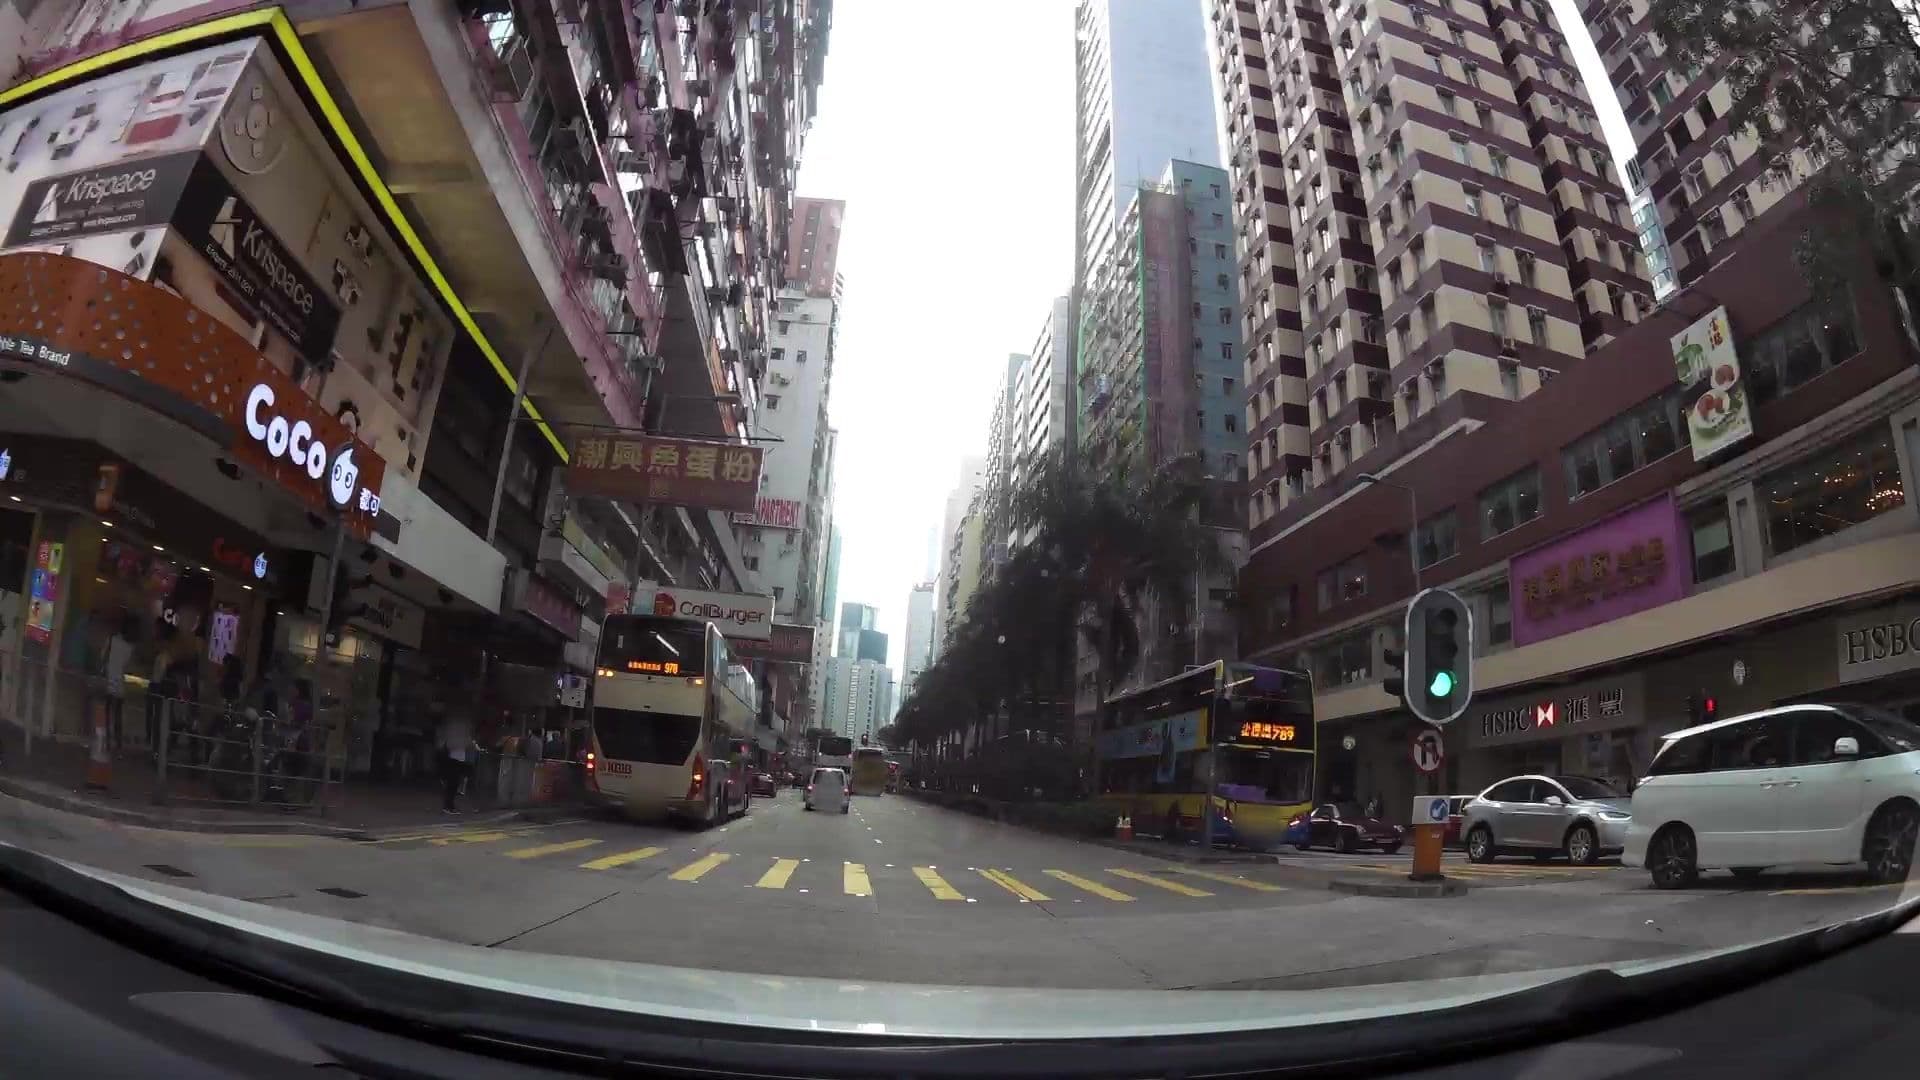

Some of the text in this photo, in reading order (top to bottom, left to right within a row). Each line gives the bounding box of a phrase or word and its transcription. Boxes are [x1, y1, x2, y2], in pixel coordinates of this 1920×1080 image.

[64, 168, 156, 204] Krispace
[242, 219, 313, 314] Krispace
[19, 340, 35, 356] Tea
[39, 345, 71, 366] Brand
[246, 383, 327, 479] CoCo
[680, 600, 765, 625] CaliBurger
[1482, 705, 1532, 738] HSBC
